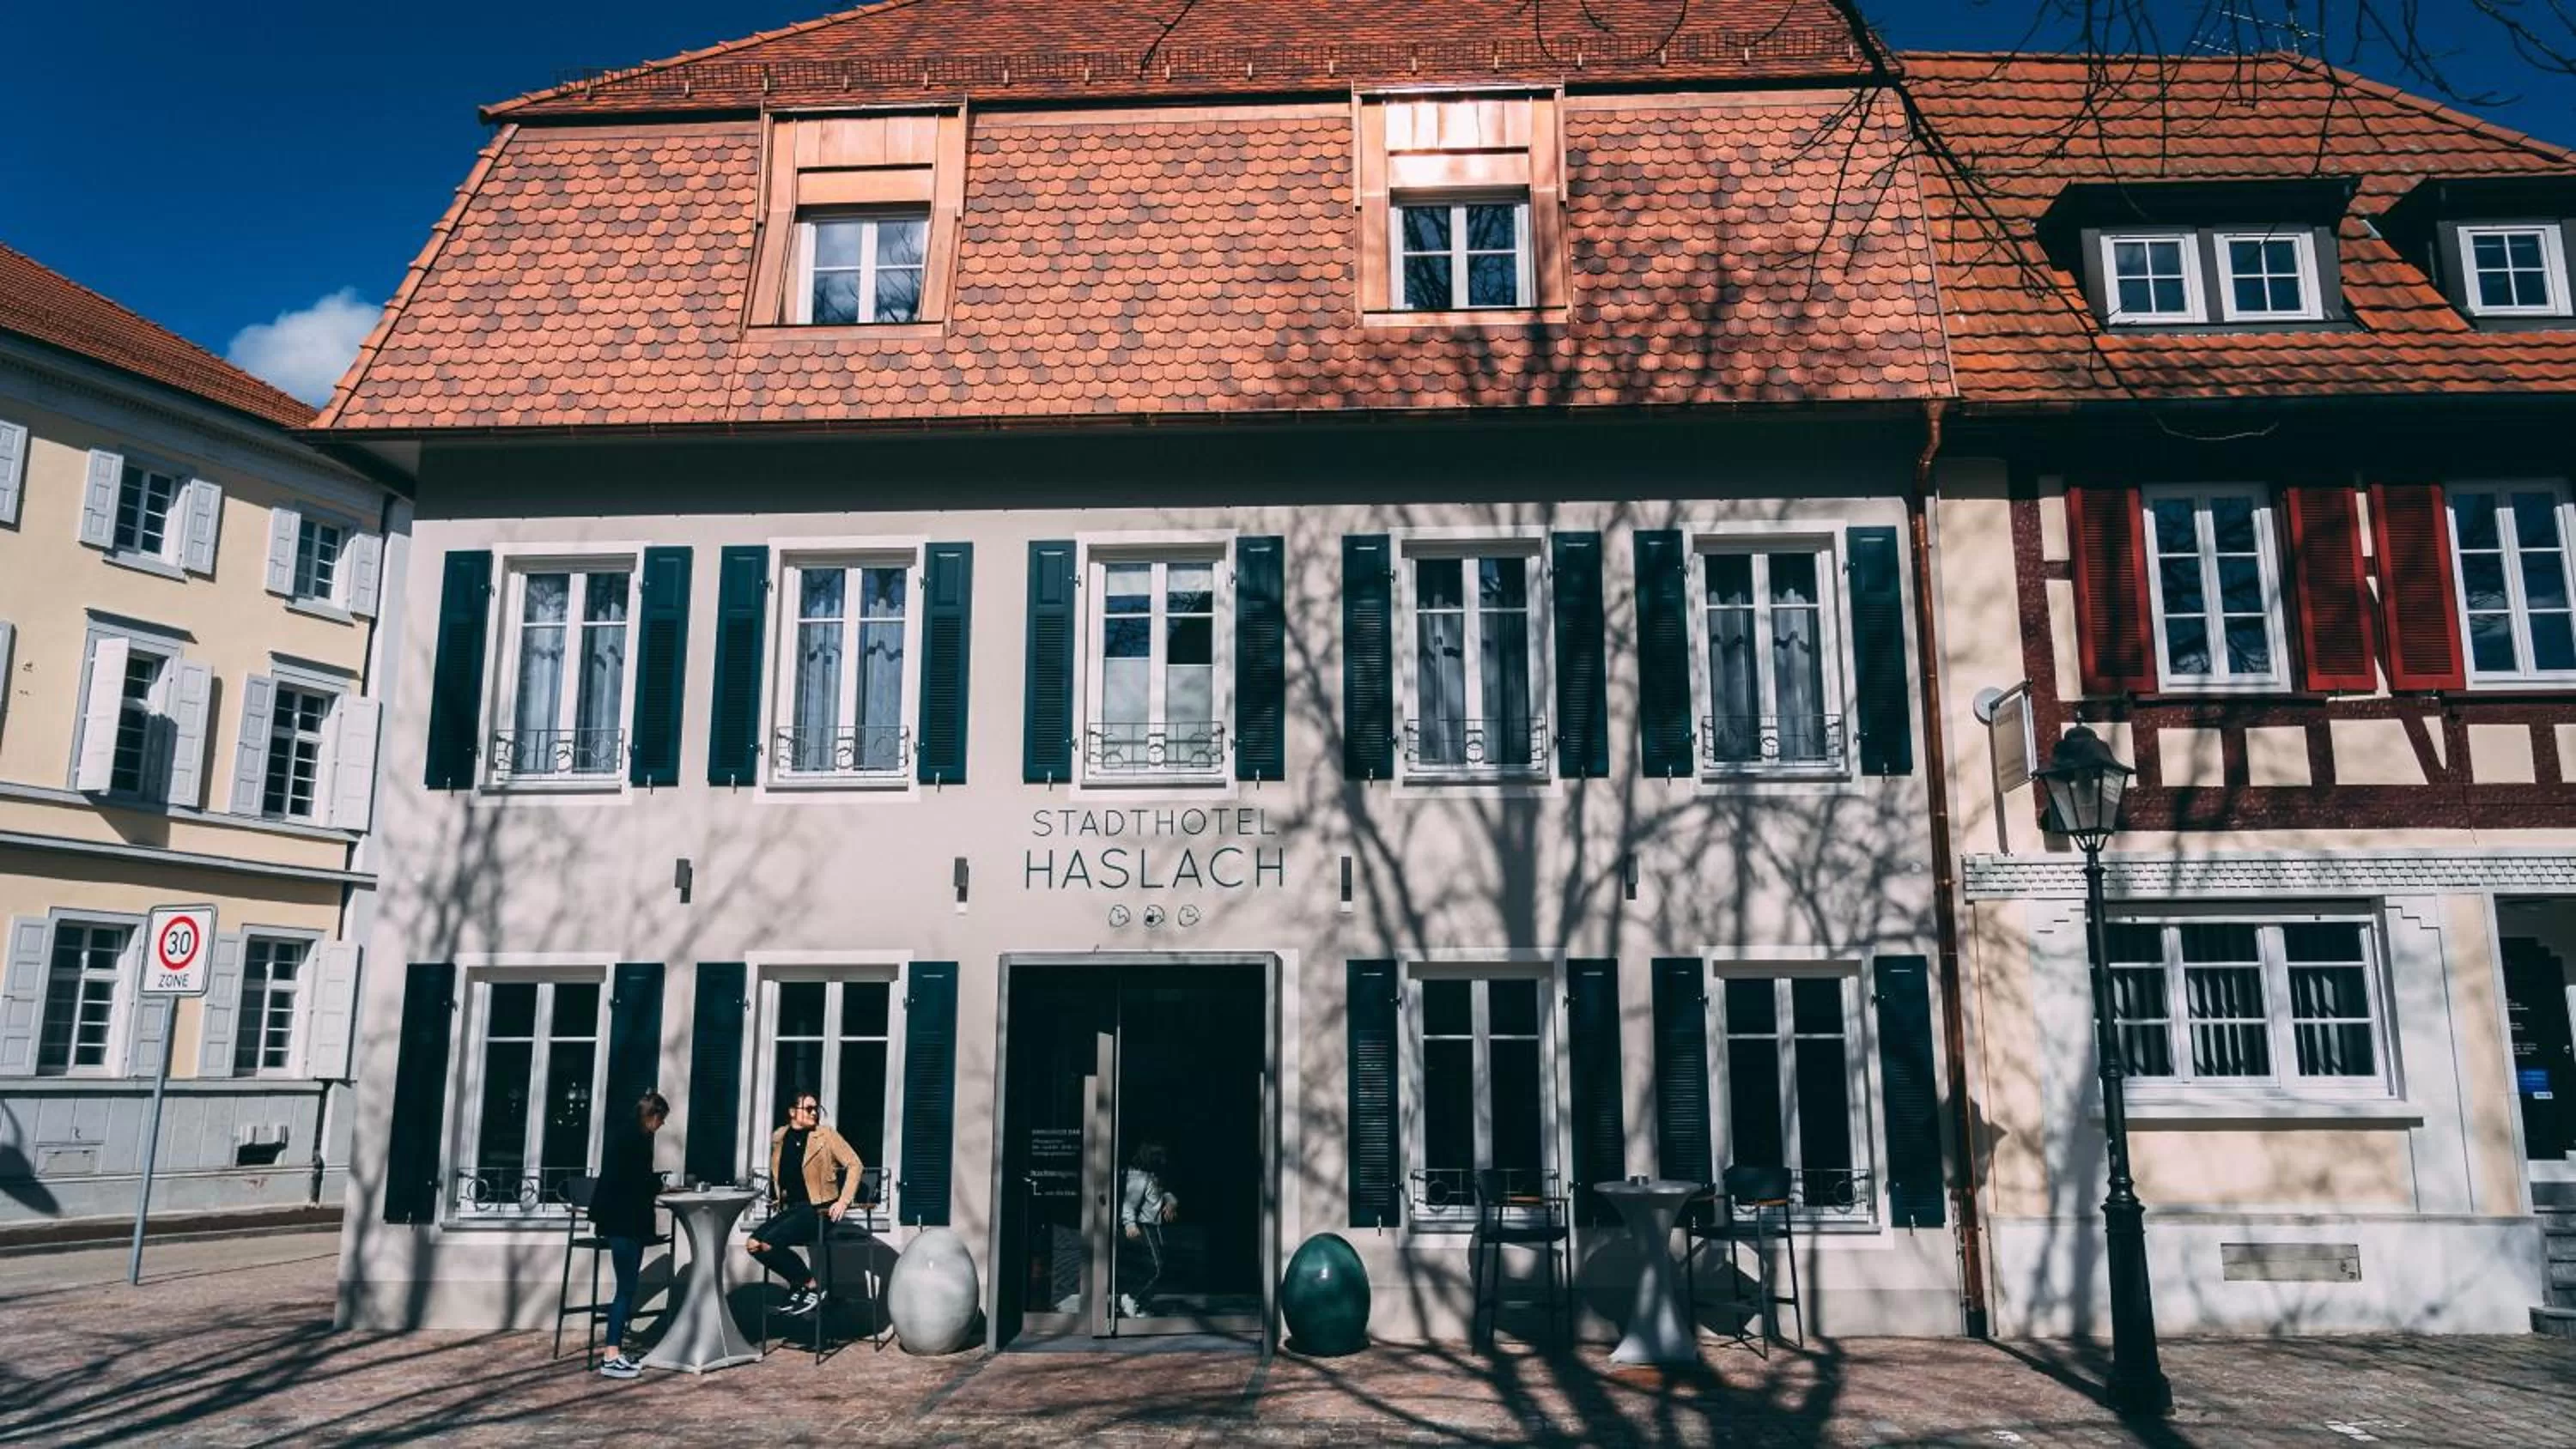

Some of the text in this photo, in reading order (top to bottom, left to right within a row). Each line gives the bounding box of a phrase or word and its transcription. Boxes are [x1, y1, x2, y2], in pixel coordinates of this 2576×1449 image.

[1032, 808, 1276, 836] STADTHOTEL
[1025, 847, 1284, 888] HASLACH
[167, 931, 191, 955] 30
[158, 973, 190, 988] ZONE
